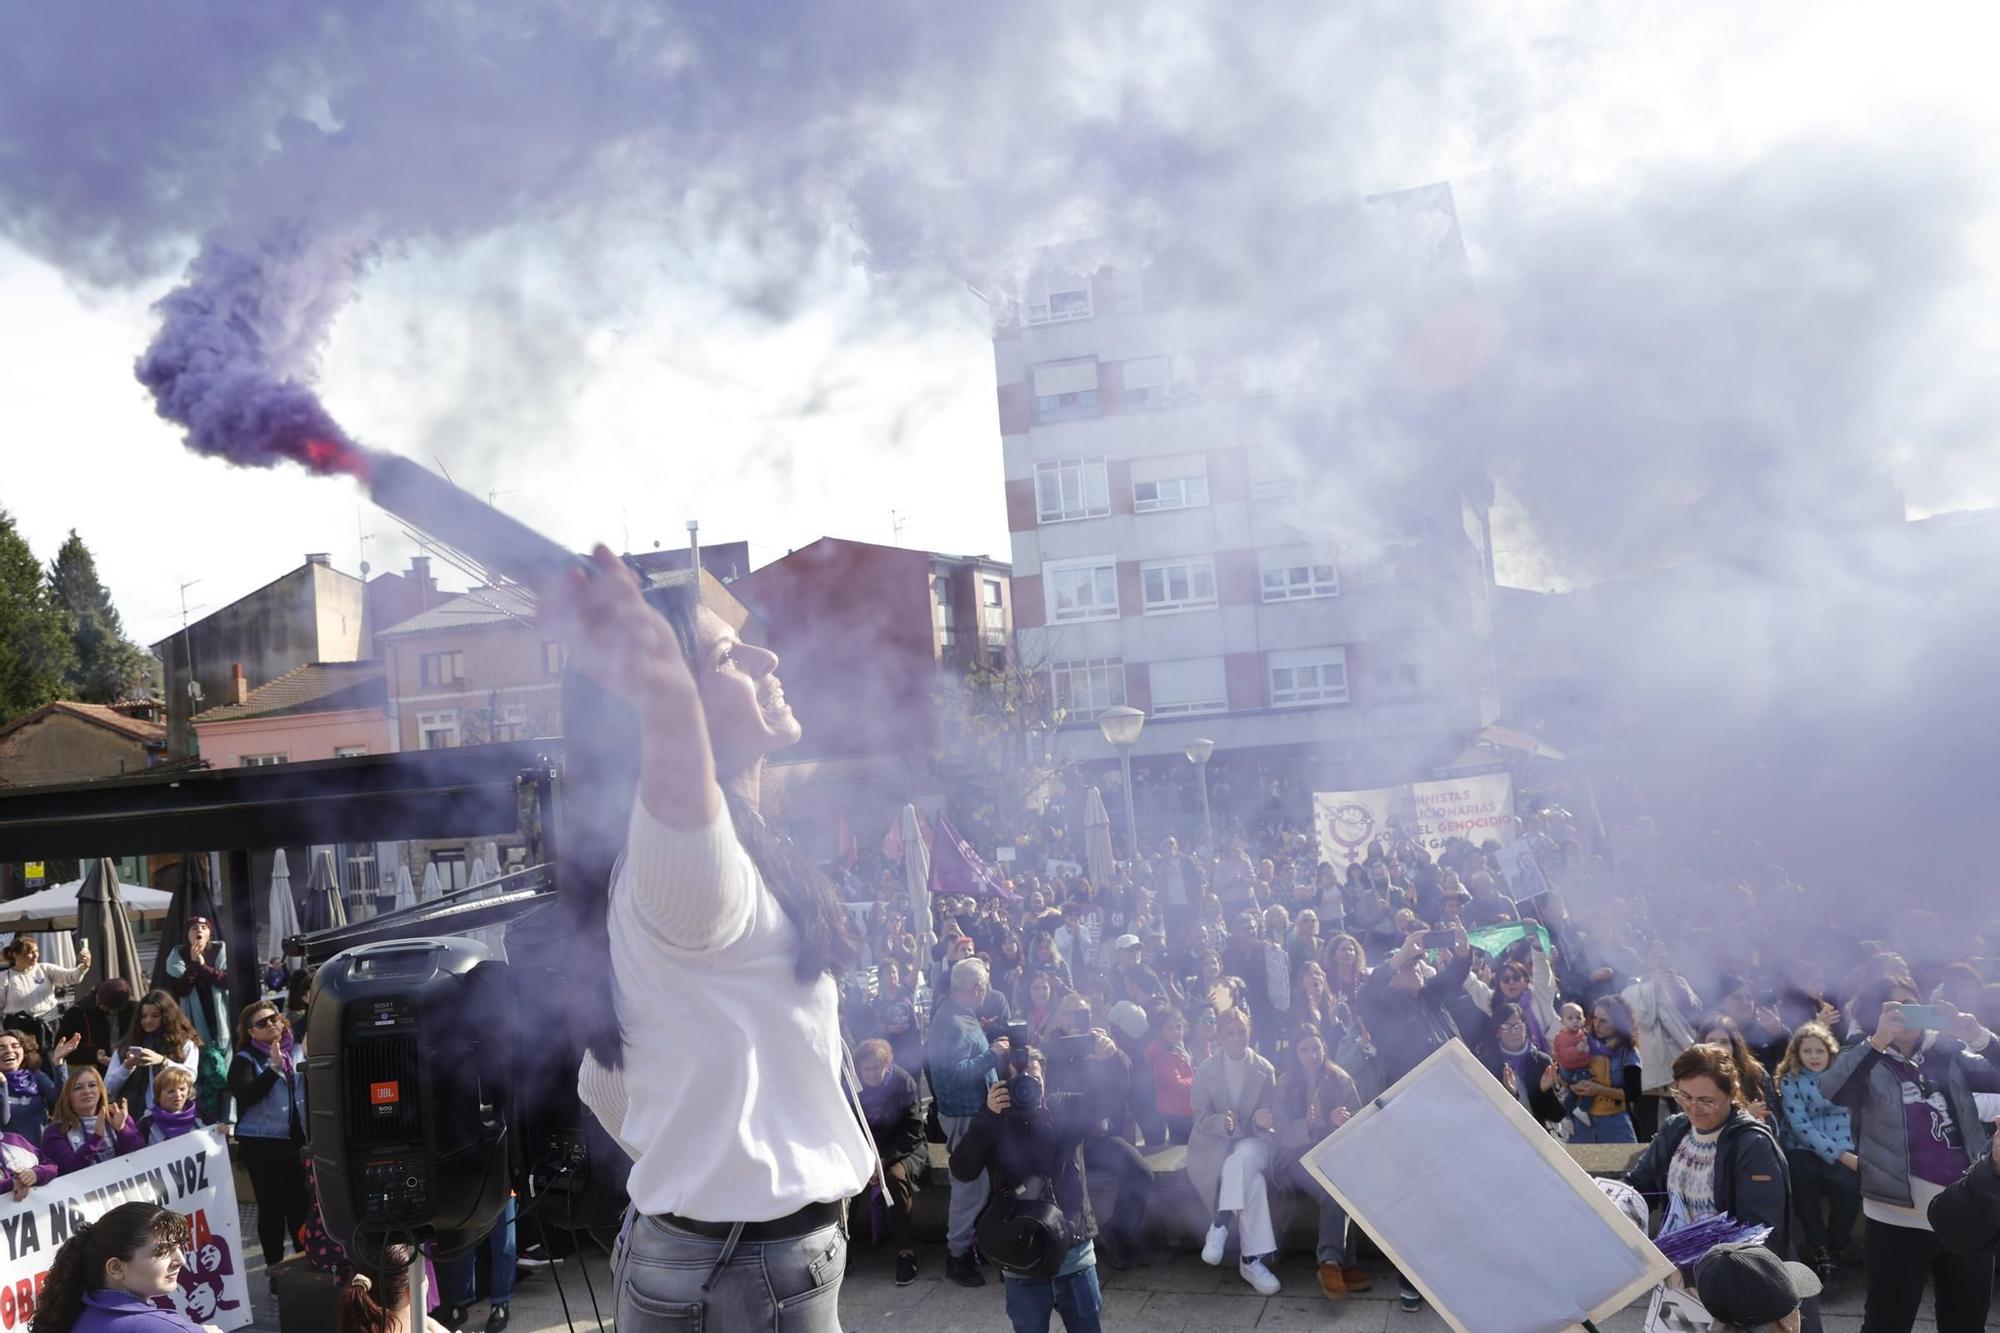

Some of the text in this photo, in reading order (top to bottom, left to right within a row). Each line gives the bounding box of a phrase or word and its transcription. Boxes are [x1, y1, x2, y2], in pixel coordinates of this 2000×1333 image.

[1438, 814, 1512, 834] GENOCIDIO
[377, 1088, 394, 1098] JBL
[1, 1211, 40, 1261] YA
[49, 1197, 86, 1245] NO
[167, 1151, 209, 1199] VOZ
